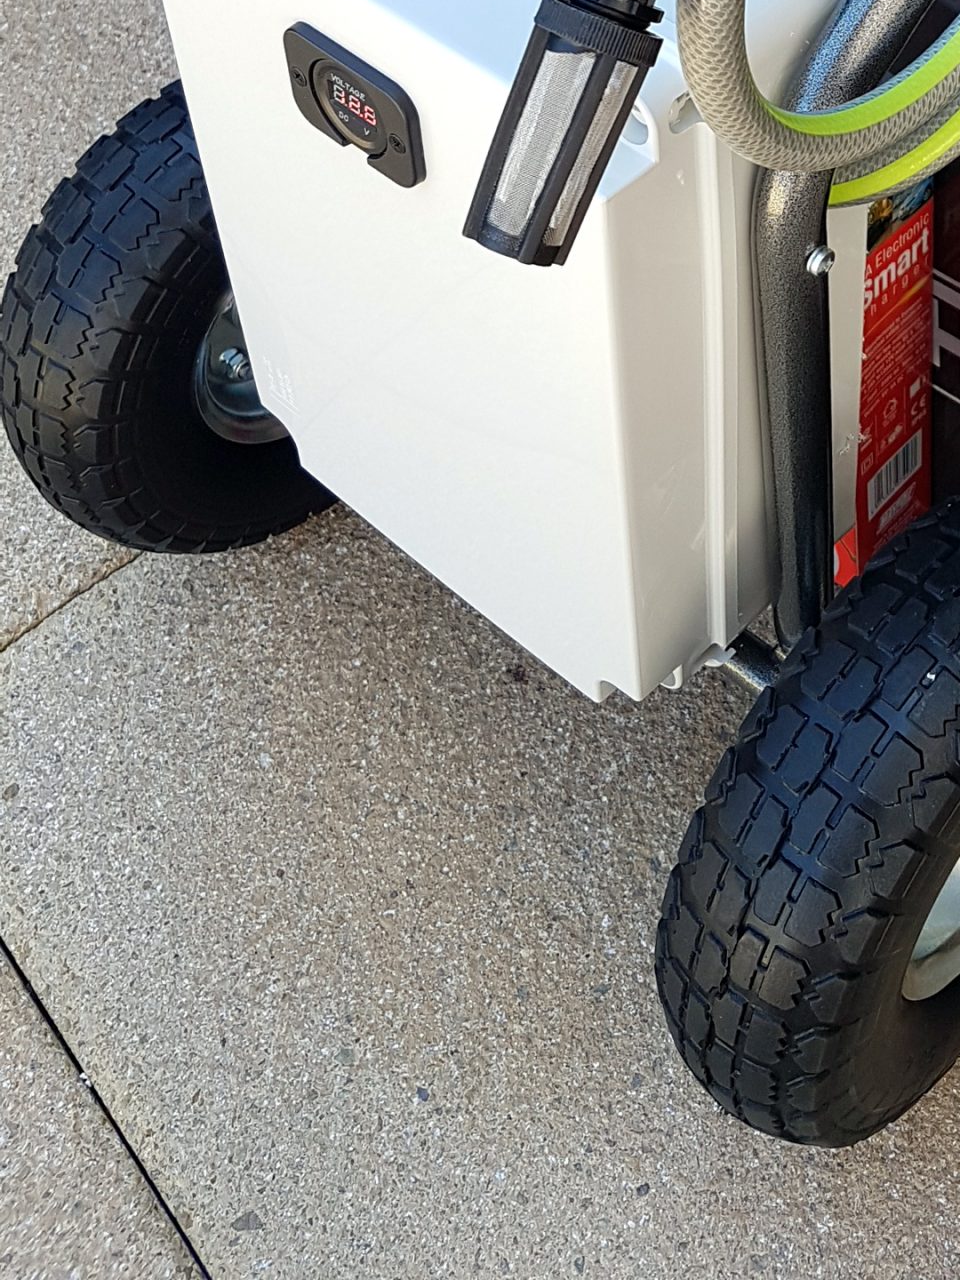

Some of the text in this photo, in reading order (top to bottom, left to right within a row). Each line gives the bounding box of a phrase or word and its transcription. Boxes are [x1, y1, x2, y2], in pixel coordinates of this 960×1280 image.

[330, 73, 366, 102] VOLTAGE
[363, 127, 371, 136] V
[875, 213, 930, 268] Electronic
